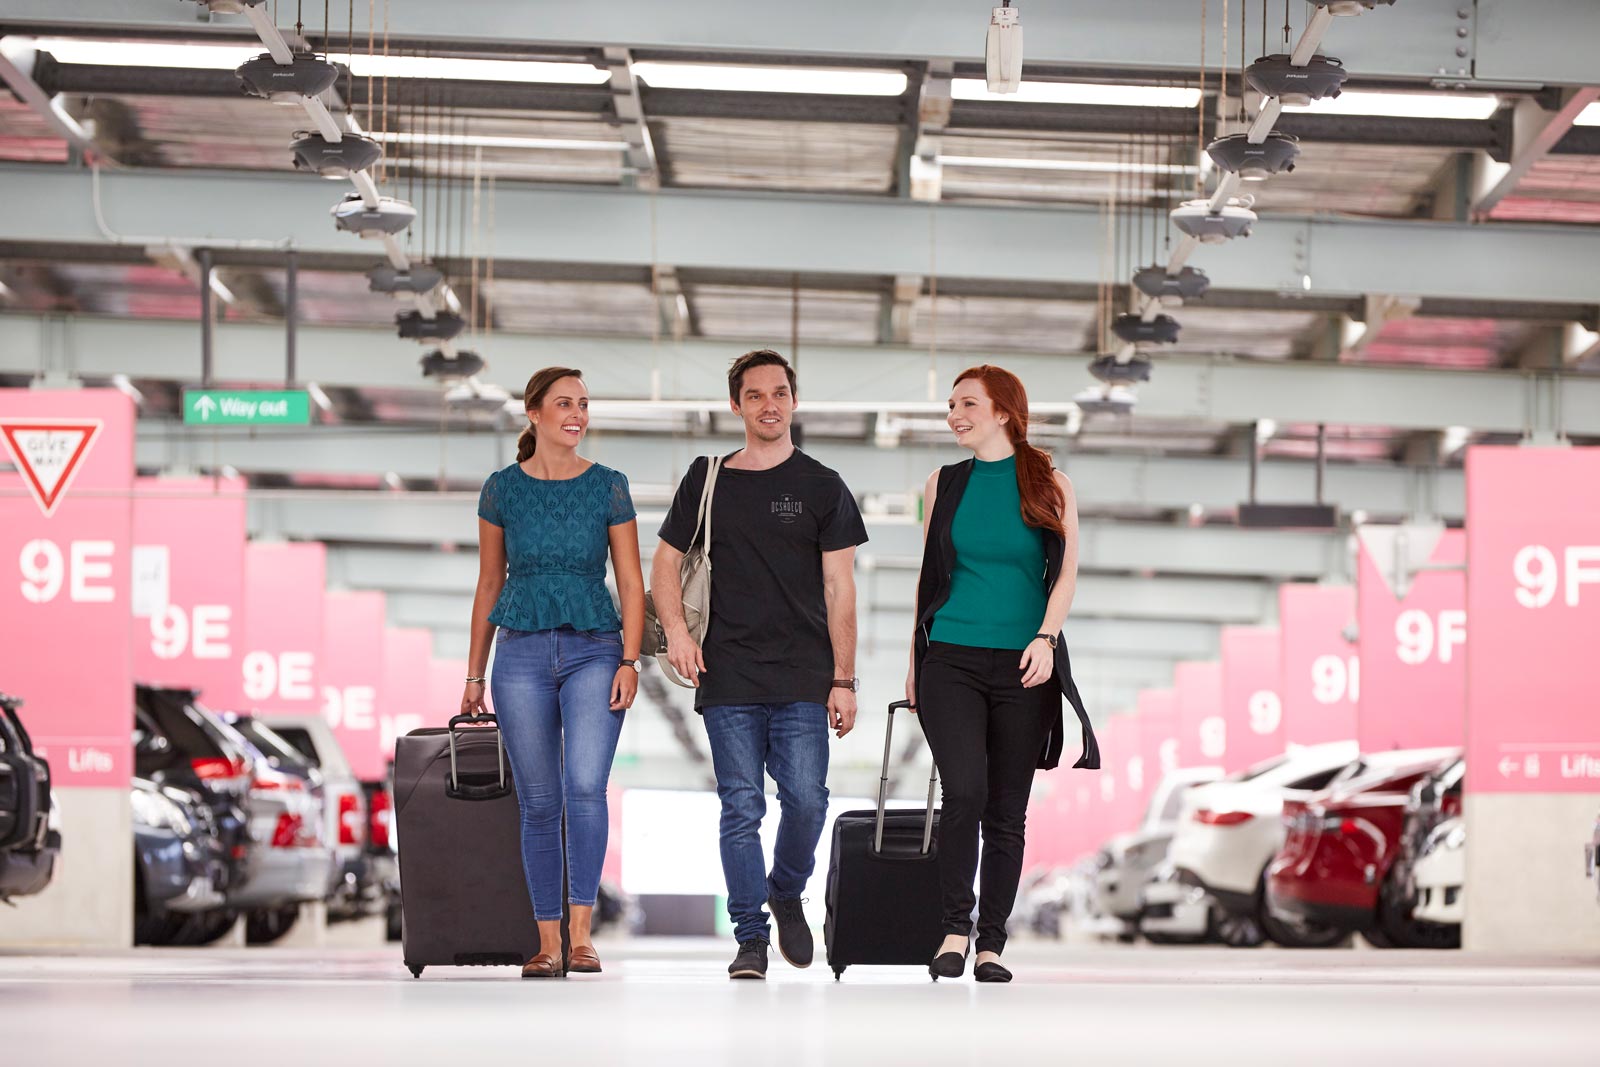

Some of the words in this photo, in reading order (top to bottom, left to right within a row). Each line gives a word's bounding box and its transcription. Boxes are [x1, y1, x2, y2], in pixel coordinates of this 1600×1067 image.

[219, 398, 258, 418] Way
[259, 400, 288, 416] out
[28, 437, 67, 451] GIVE
[19, 539, 115, 603] 9E
[149, 604, 232, 660] 9E
[1395, 609, 1467, 665] 9F
[242, 652, 314, 700] 9E
[68, 746, 113, 774] Lifts
